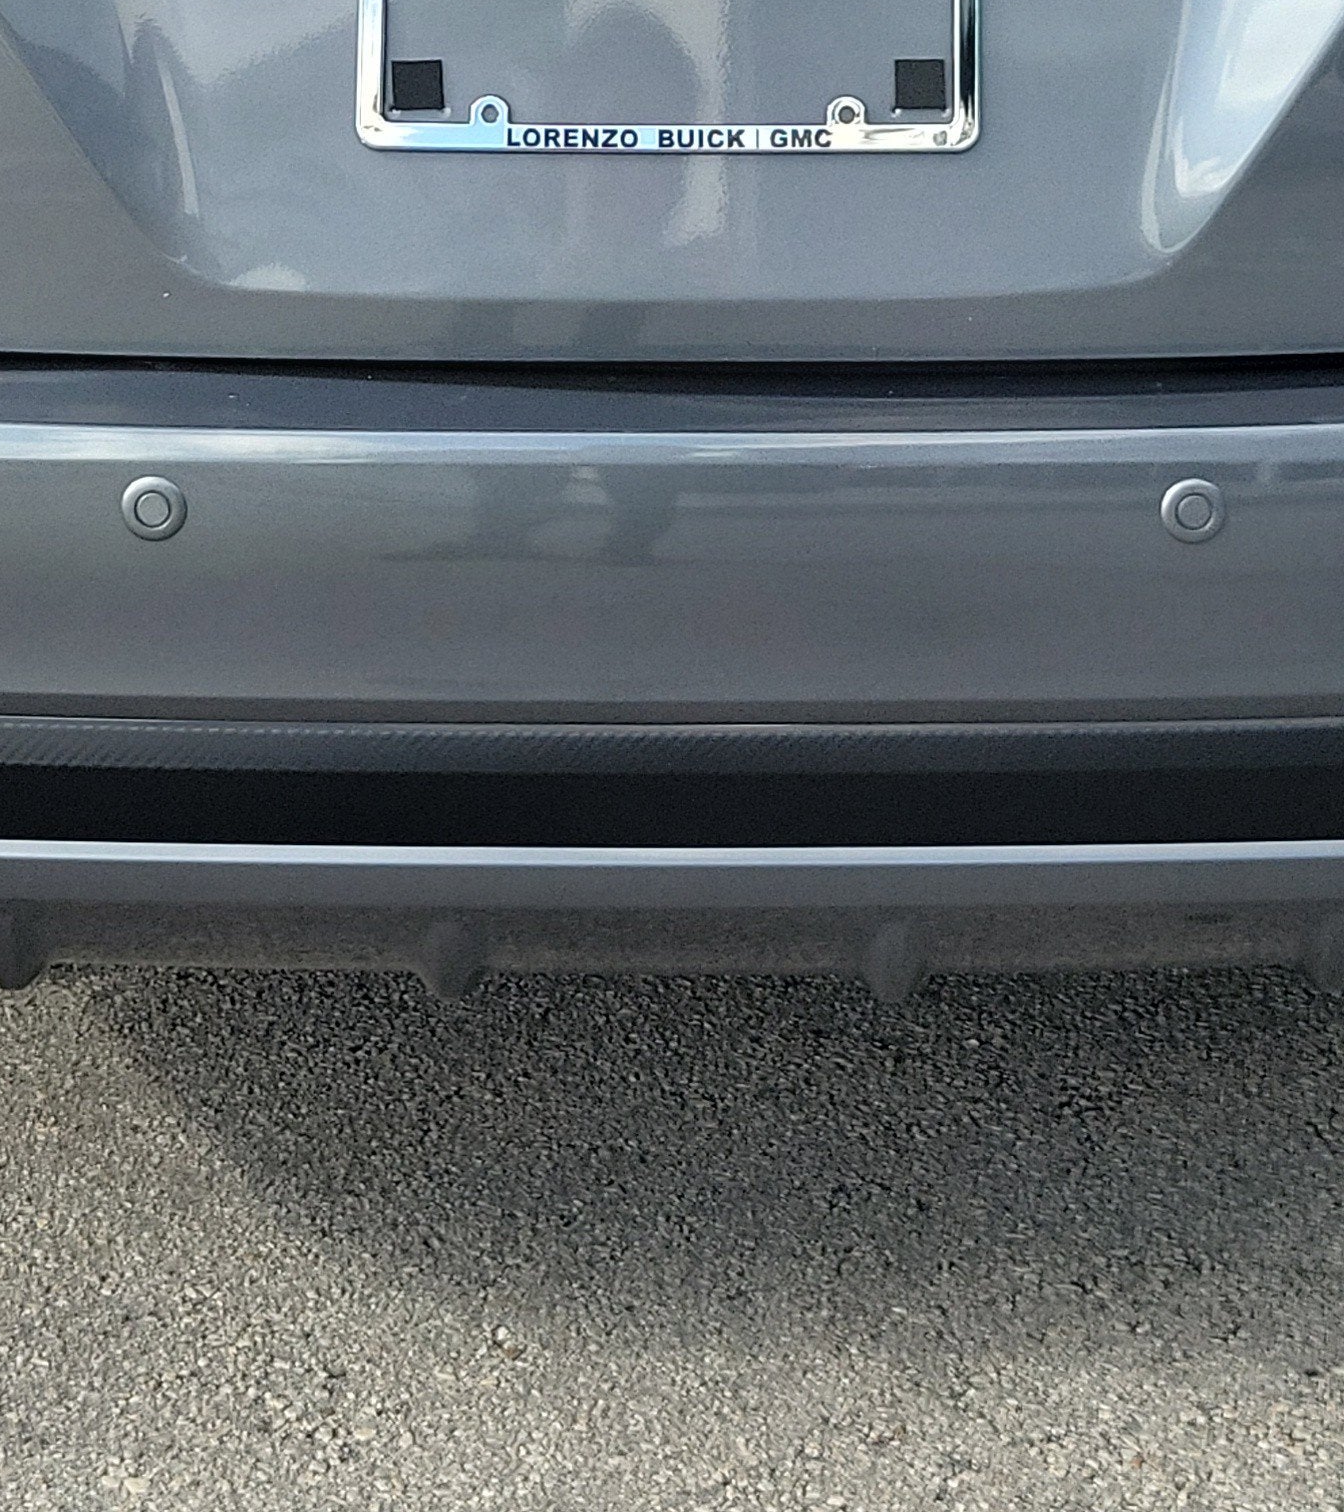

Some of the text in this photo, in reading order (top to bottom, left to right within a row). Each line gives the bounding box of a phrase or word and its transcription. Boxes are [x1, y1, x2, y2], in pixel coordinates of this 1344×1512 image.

[506, 127, 833, 149] LORENZO BUICK GMC
